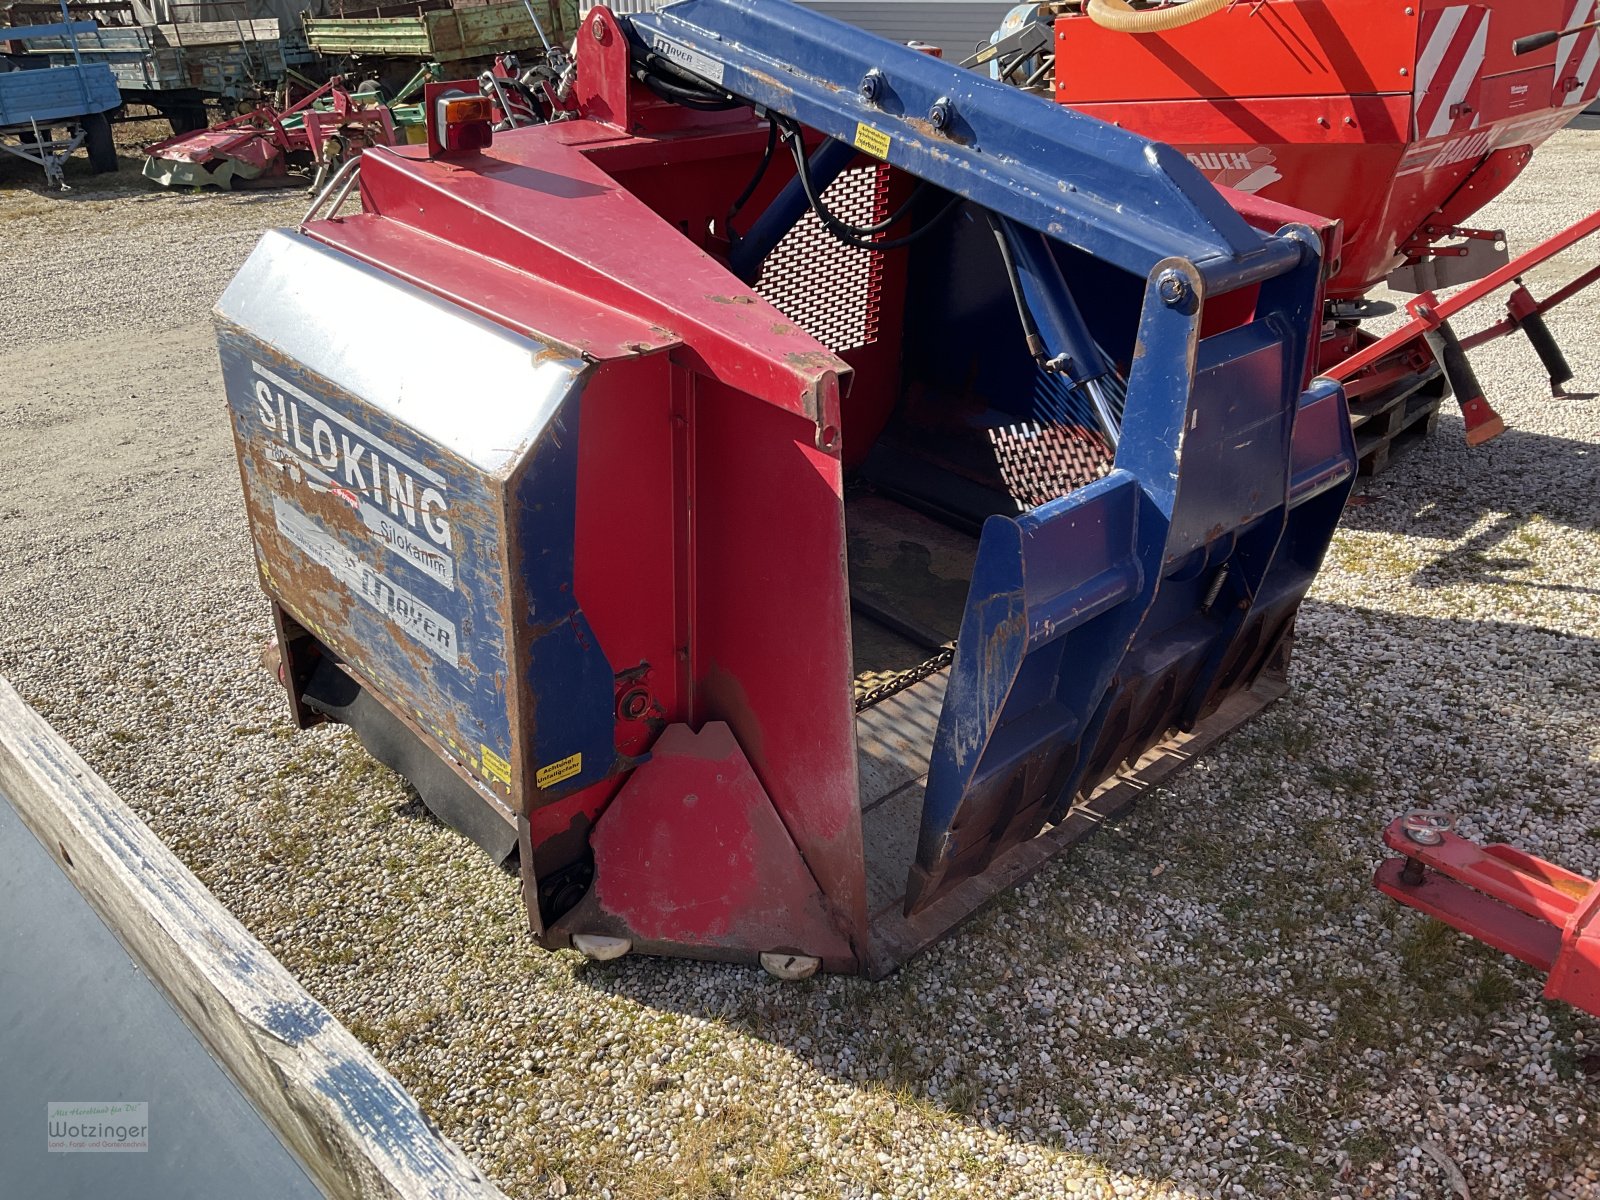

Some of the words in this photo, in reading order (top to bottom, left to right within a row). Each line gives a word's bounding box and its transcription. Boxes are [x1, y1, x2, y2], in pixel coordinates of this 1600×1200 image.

[656, 38, 693, 63] MAYER
[255, 380, 453, 551] SILOKING
[361, 567, 451, 649] MAYER
[537, 762, 580, 784] Unfallgefahr
[543, 757, 575, 774] Achtung!
